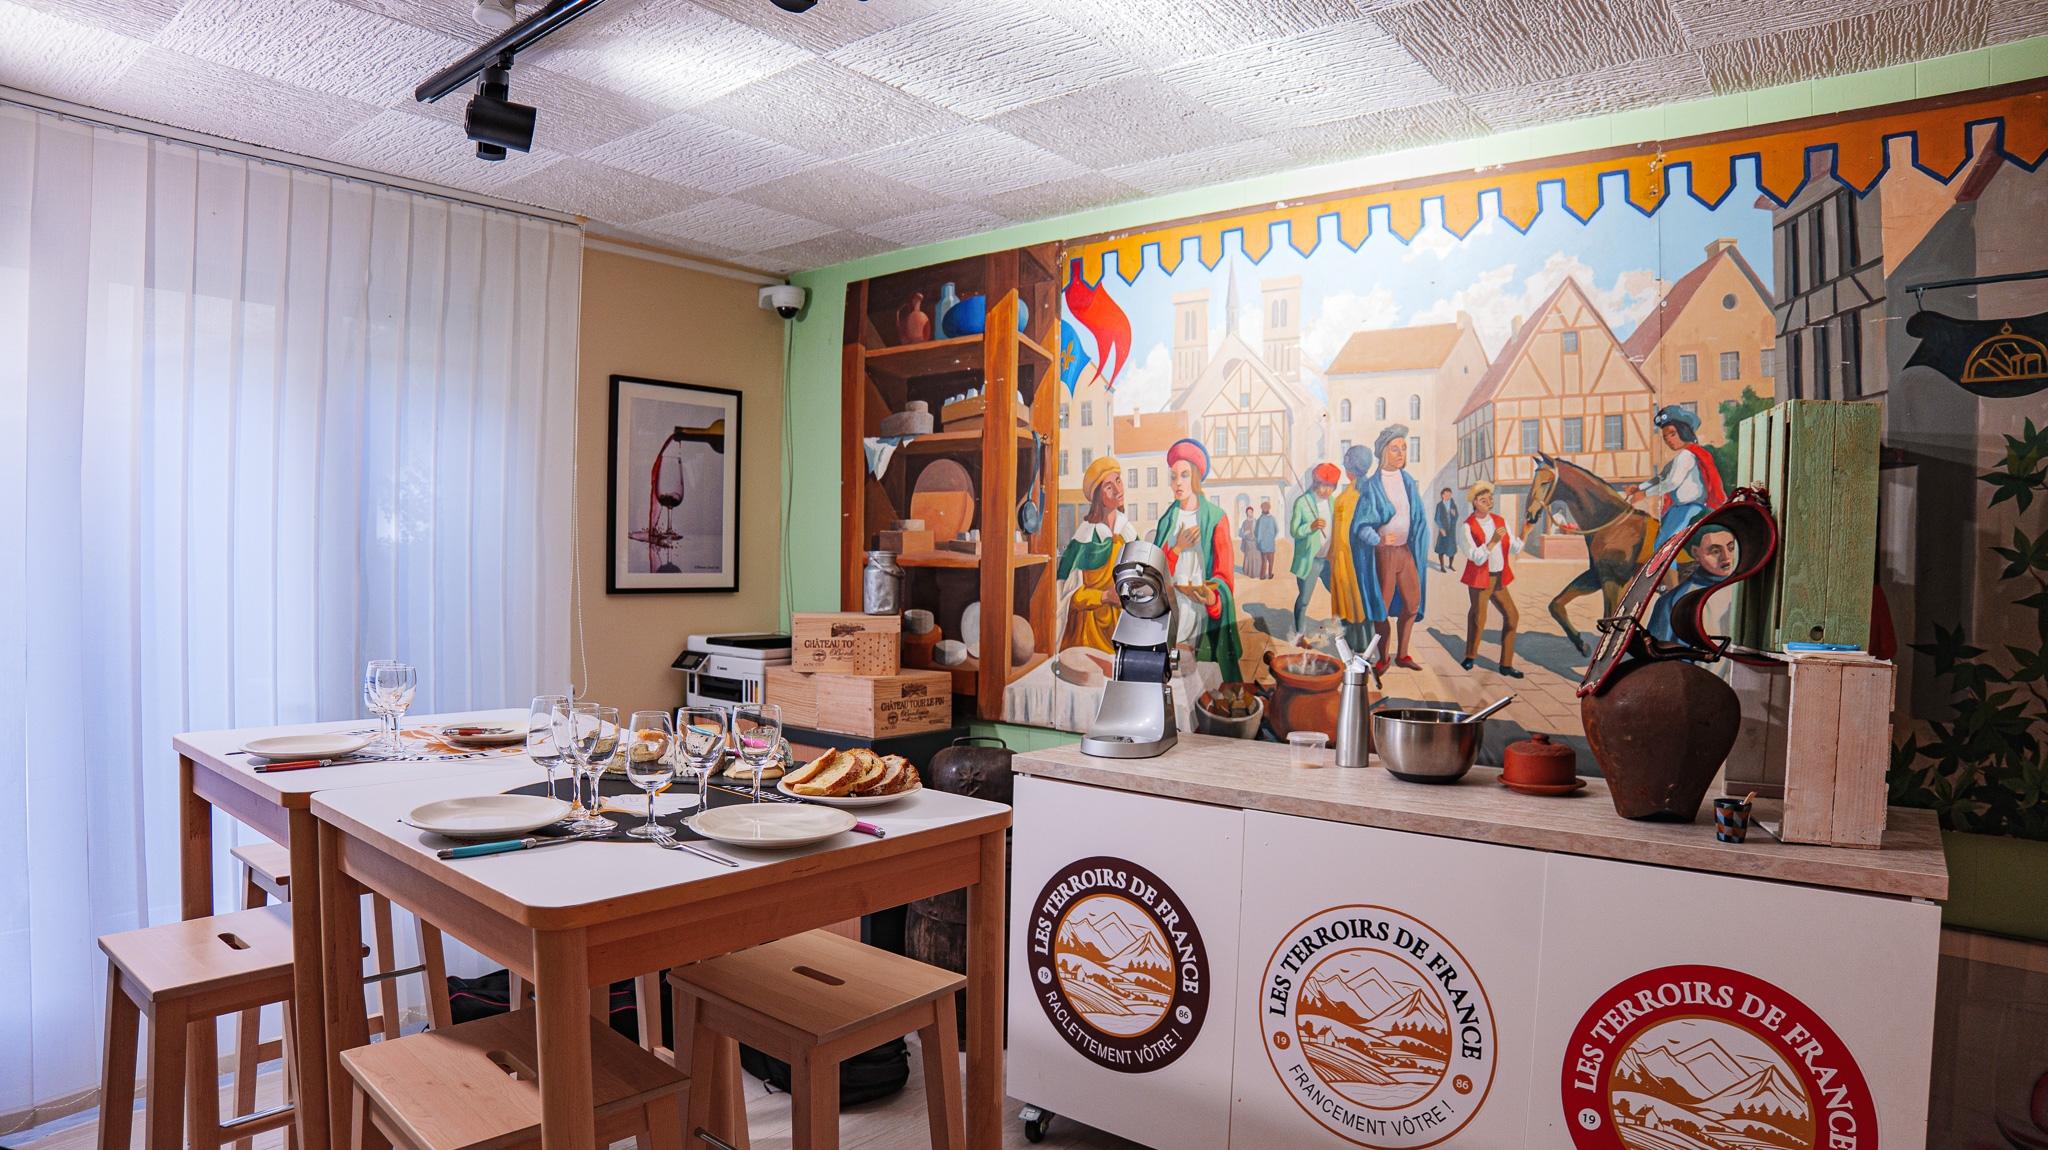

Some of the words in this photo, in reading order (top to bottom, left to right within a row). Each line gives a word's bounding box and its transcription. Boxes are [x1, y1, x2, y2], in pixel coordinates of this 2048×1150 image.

[804, 638, 840, 649] CHÂTEAU
[842, 640, 854, 648] TO
[880, 700, 908, 711] CHÂTEAU
[911, 698, 925, 708] TOUR
[1034, 918, 1052, 956] LES
[1045, 868, 1127, 917] TERROIRS
[1129, 876, 1158, 906] DE
[1154, 898, 1200, 994] FRANCE
[1039, 971, 1050, 981] 19
[1269, 974, 1292, 1017] LES
[1281, 918, 1390, 975] TERROIRS
[1392, 927, 1430, 959] DE
[1425, 952, 1482, 1060] FRANCE
[1178, 1009, 1190, 1020] 86
[1045, 990, 1132, 1065] RACLETTEMENT
[1134, 1033, 1177, 1065] VÔTRE
[1275, 1034, 1288, 1046] 19
[1574, 1043, 1605, 1093] LES
[1590, 981, 1734, 1044] TERROIRS
[1738, 991, 1787, 1032] DE
[1781, 1022, 1857, 1150] FRANCE
[1455, 1079, 1470, 1090] 86
[1288, 1064, 1388, 1137] FRANCEMENT
[1390, 1104, 1447, 1137] VÔTRE
[1581, 1112, 1597, 1125] 19
